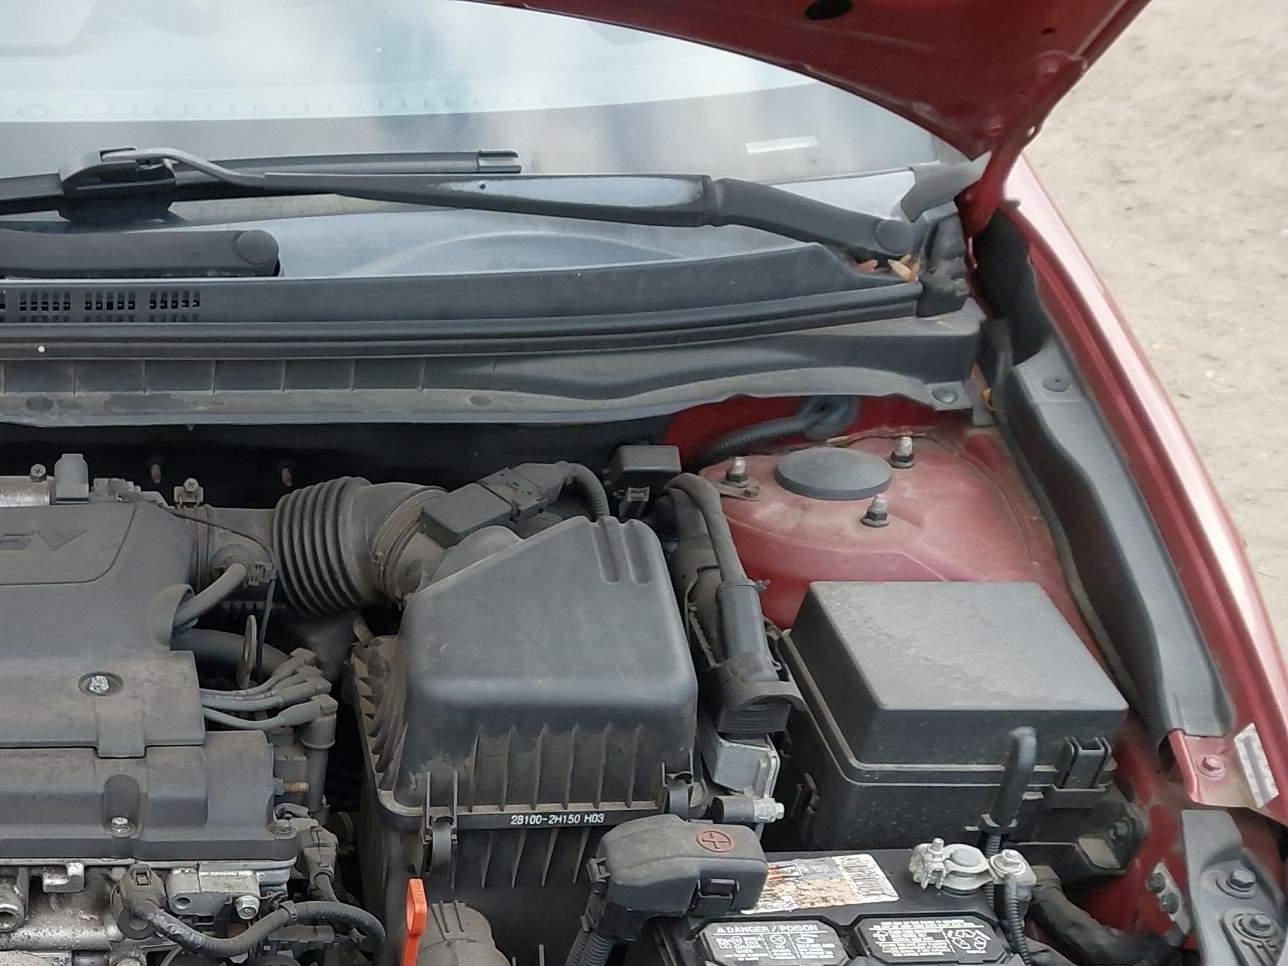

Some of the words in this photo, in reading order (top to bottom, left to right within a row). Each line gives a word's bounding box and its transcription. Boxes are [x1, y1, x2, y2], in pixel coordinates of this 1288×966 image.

[510, 814, 581, 825] 28100-2H150
[583, 813, 605, 823] H03
[727, 925, 769, 933] DANGER
[779, 924, 819, 932] POISON
